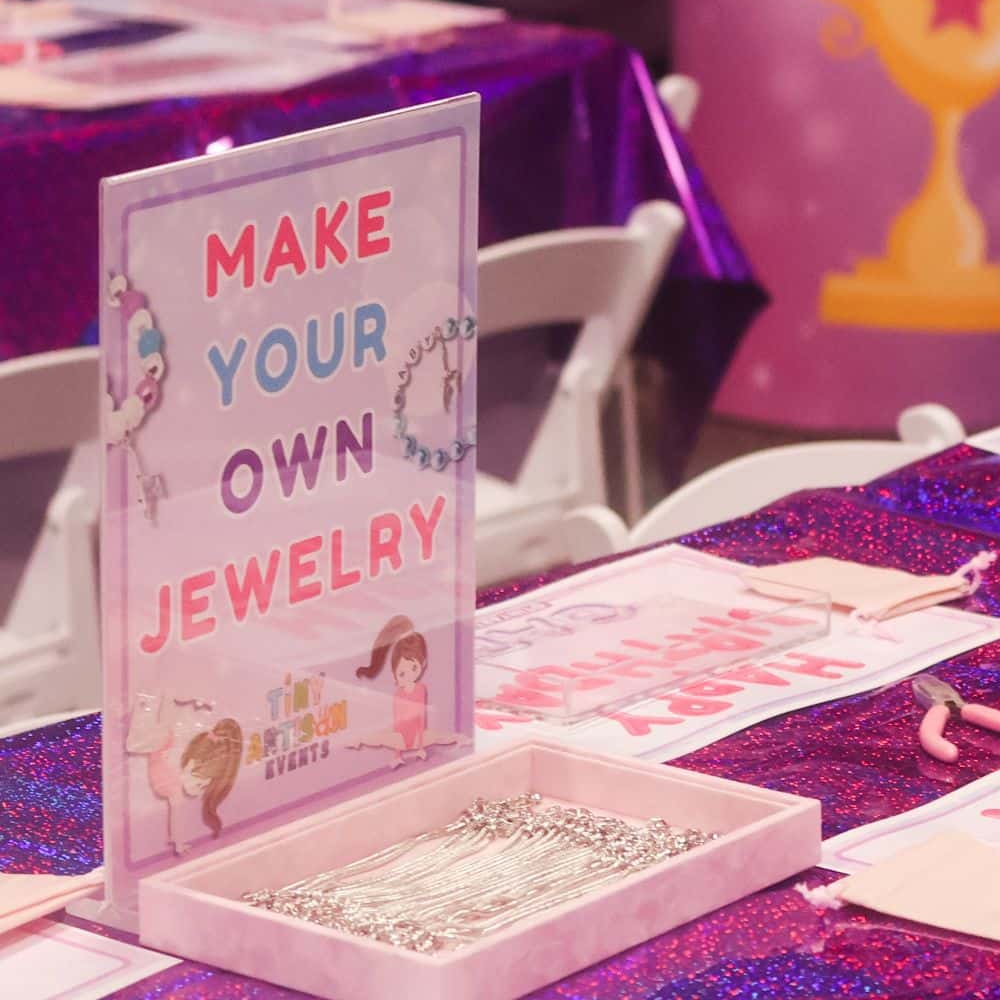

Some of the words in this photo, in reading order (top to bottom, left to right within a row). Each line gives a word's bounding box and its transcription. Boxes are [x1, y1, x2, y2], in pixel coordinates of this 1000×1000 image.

[206, 191, 391, 298] MAKE
[208, 303, 387, 407] YOUR
[221, 412, 373, 514] OWN
[140, 496, 446, 654] JEWELRY
[265, 740, 330, 780] EVENTS
